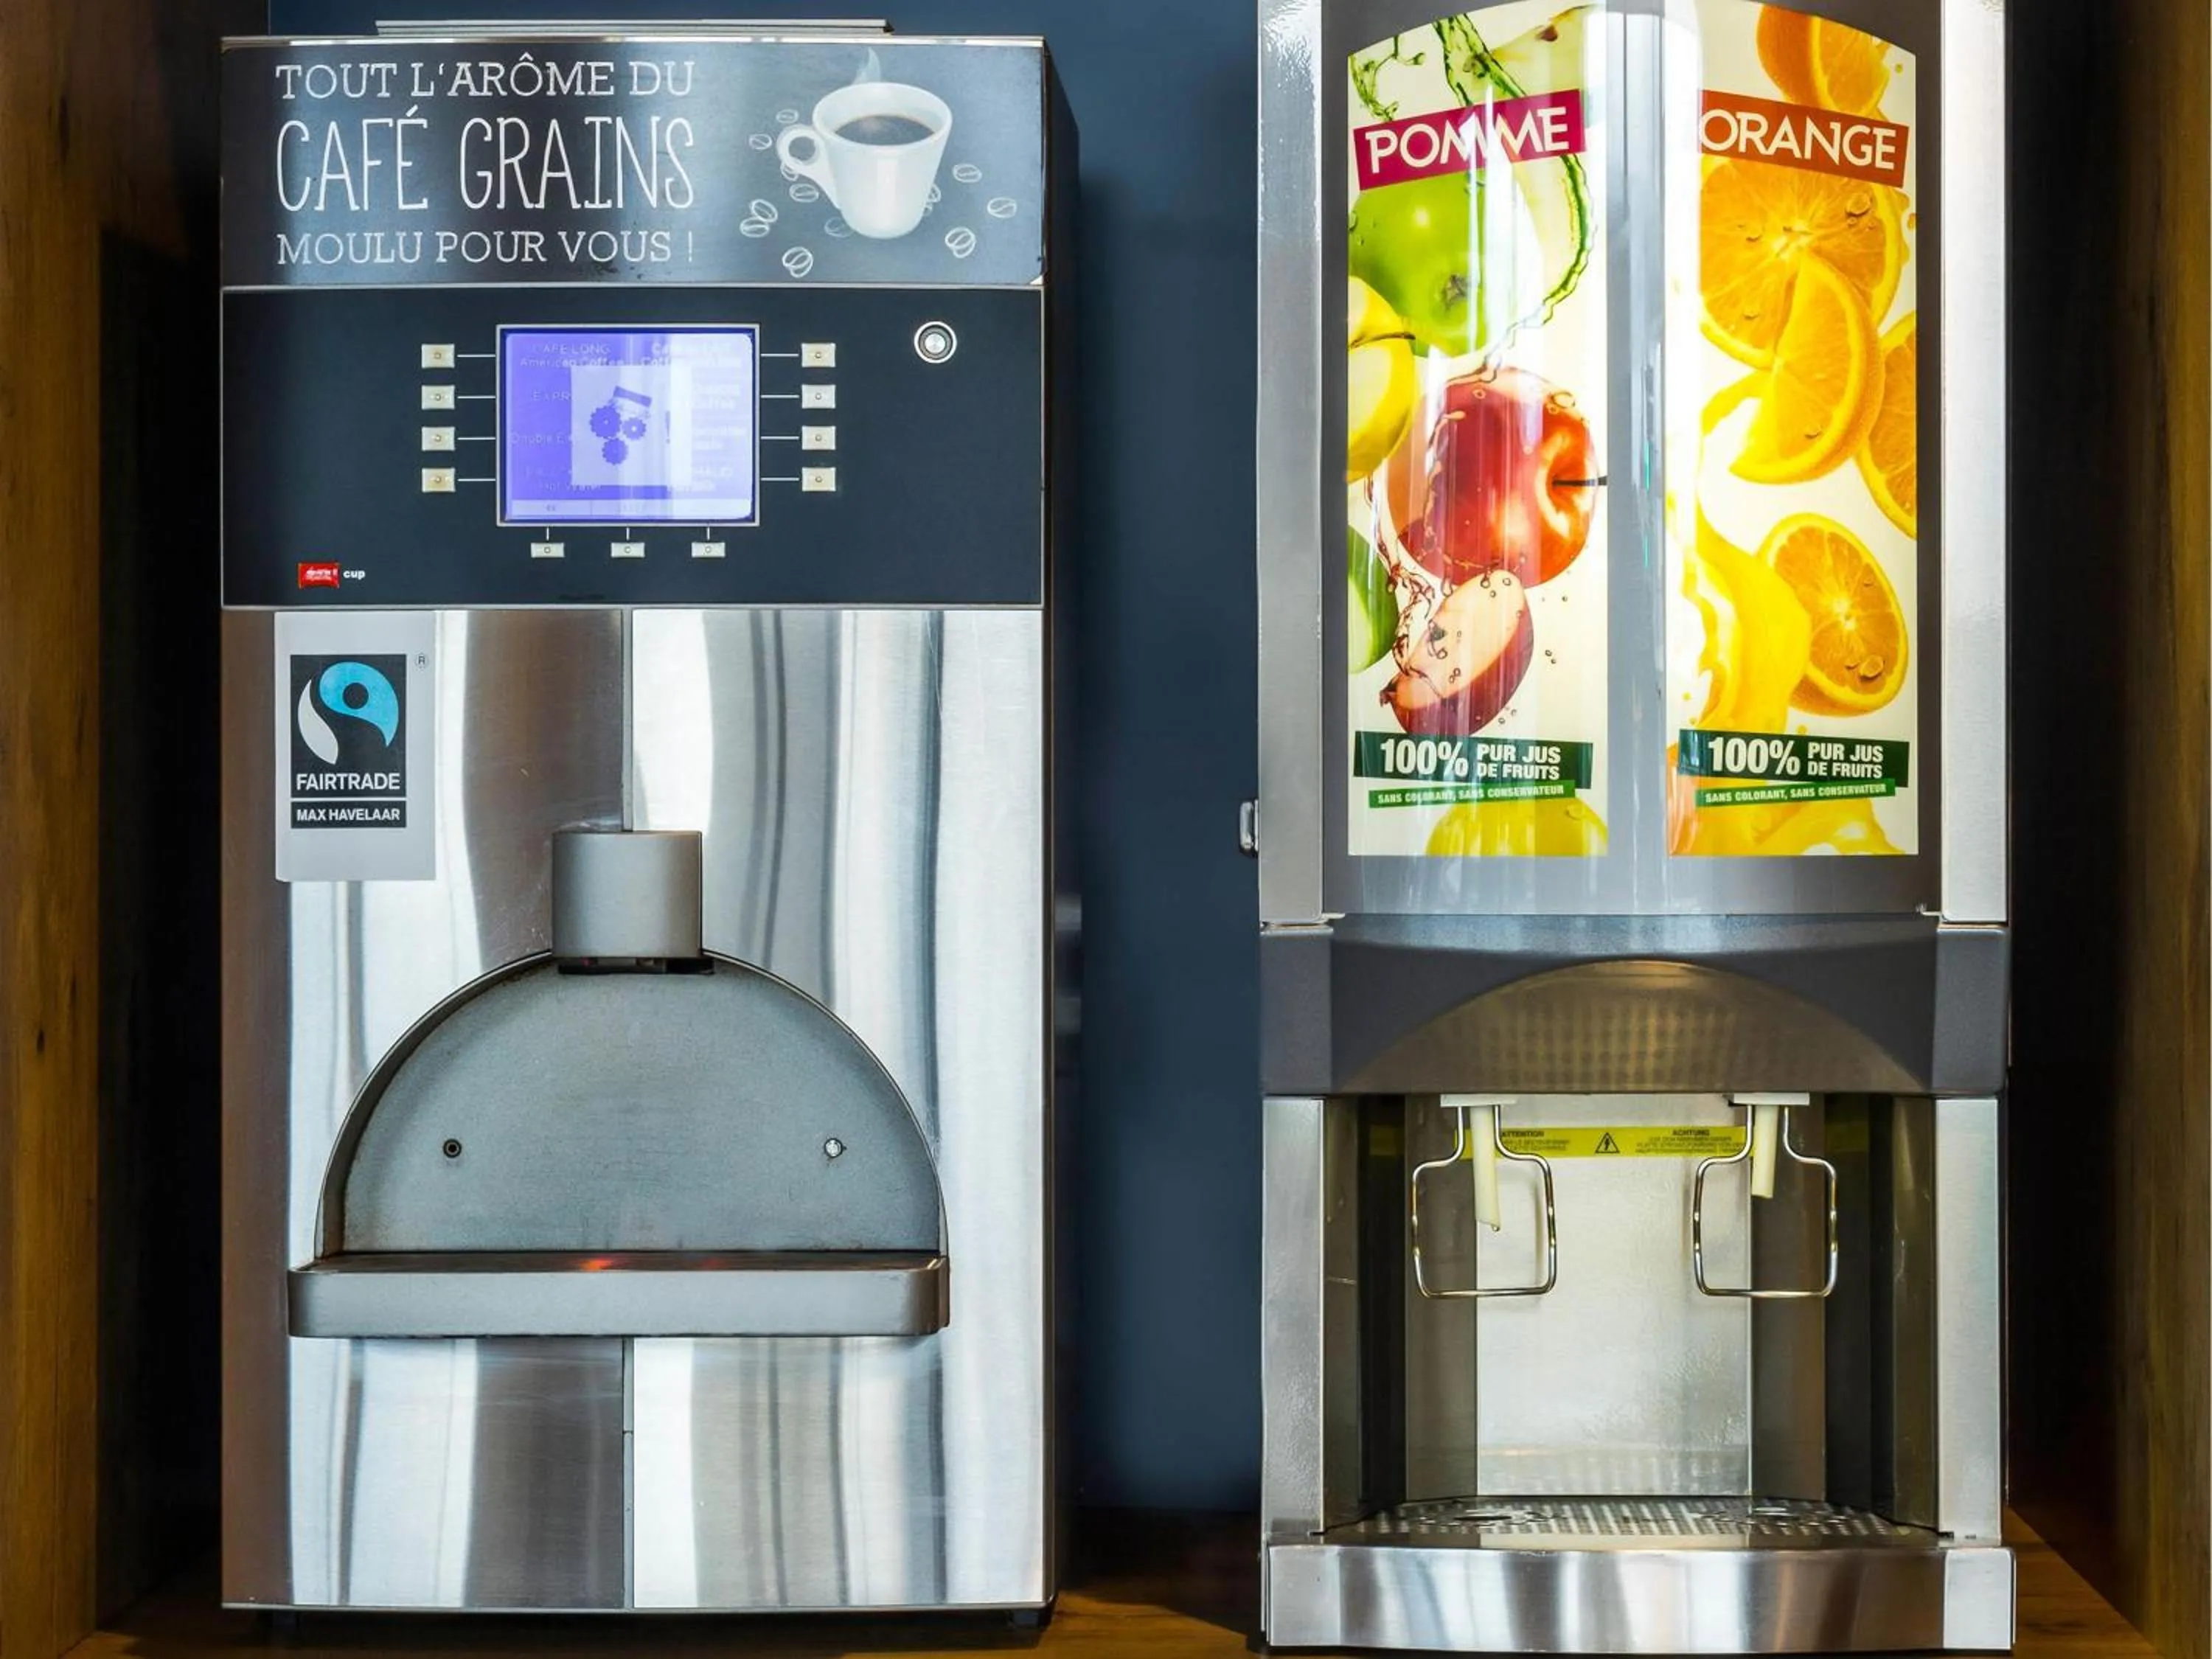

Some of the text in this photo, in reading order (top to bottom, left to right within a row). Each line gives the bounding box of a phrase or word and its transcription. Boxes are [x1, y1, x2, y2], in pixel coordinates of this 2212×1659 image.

[276, 63, 397, 99] TOUT
[629, 61, 694, 96] DU
[1366, 106, 1569, 173] POMME
[1700, 108, 1896, 170] ORANGE
[276, 105, 694, 211] CAFÉ GRAINS
[276, 230, 693, 264] MOULU POUR VOUS !
[343, 570, 366, 581] cup
[1380, 738, 1561, 777] 100% PUR JUS
[1708, 737, 1884, 776] 100% PUR JUS
[296, 773, 400, 790] FAIRTRADE
[1478, 762, 1559, 780] DE FRUITS
[1807, 762, 1882, 779] DE FRUITS
[1377, 785, 1564, 804] SANS COLORANT, SANS CONSERVATEUR
[1705, 784, 1887, 803] SANS COLORANT, SANS CONSERVATEUR
[296, 807, 400, 821] MAX HAVELAAR
